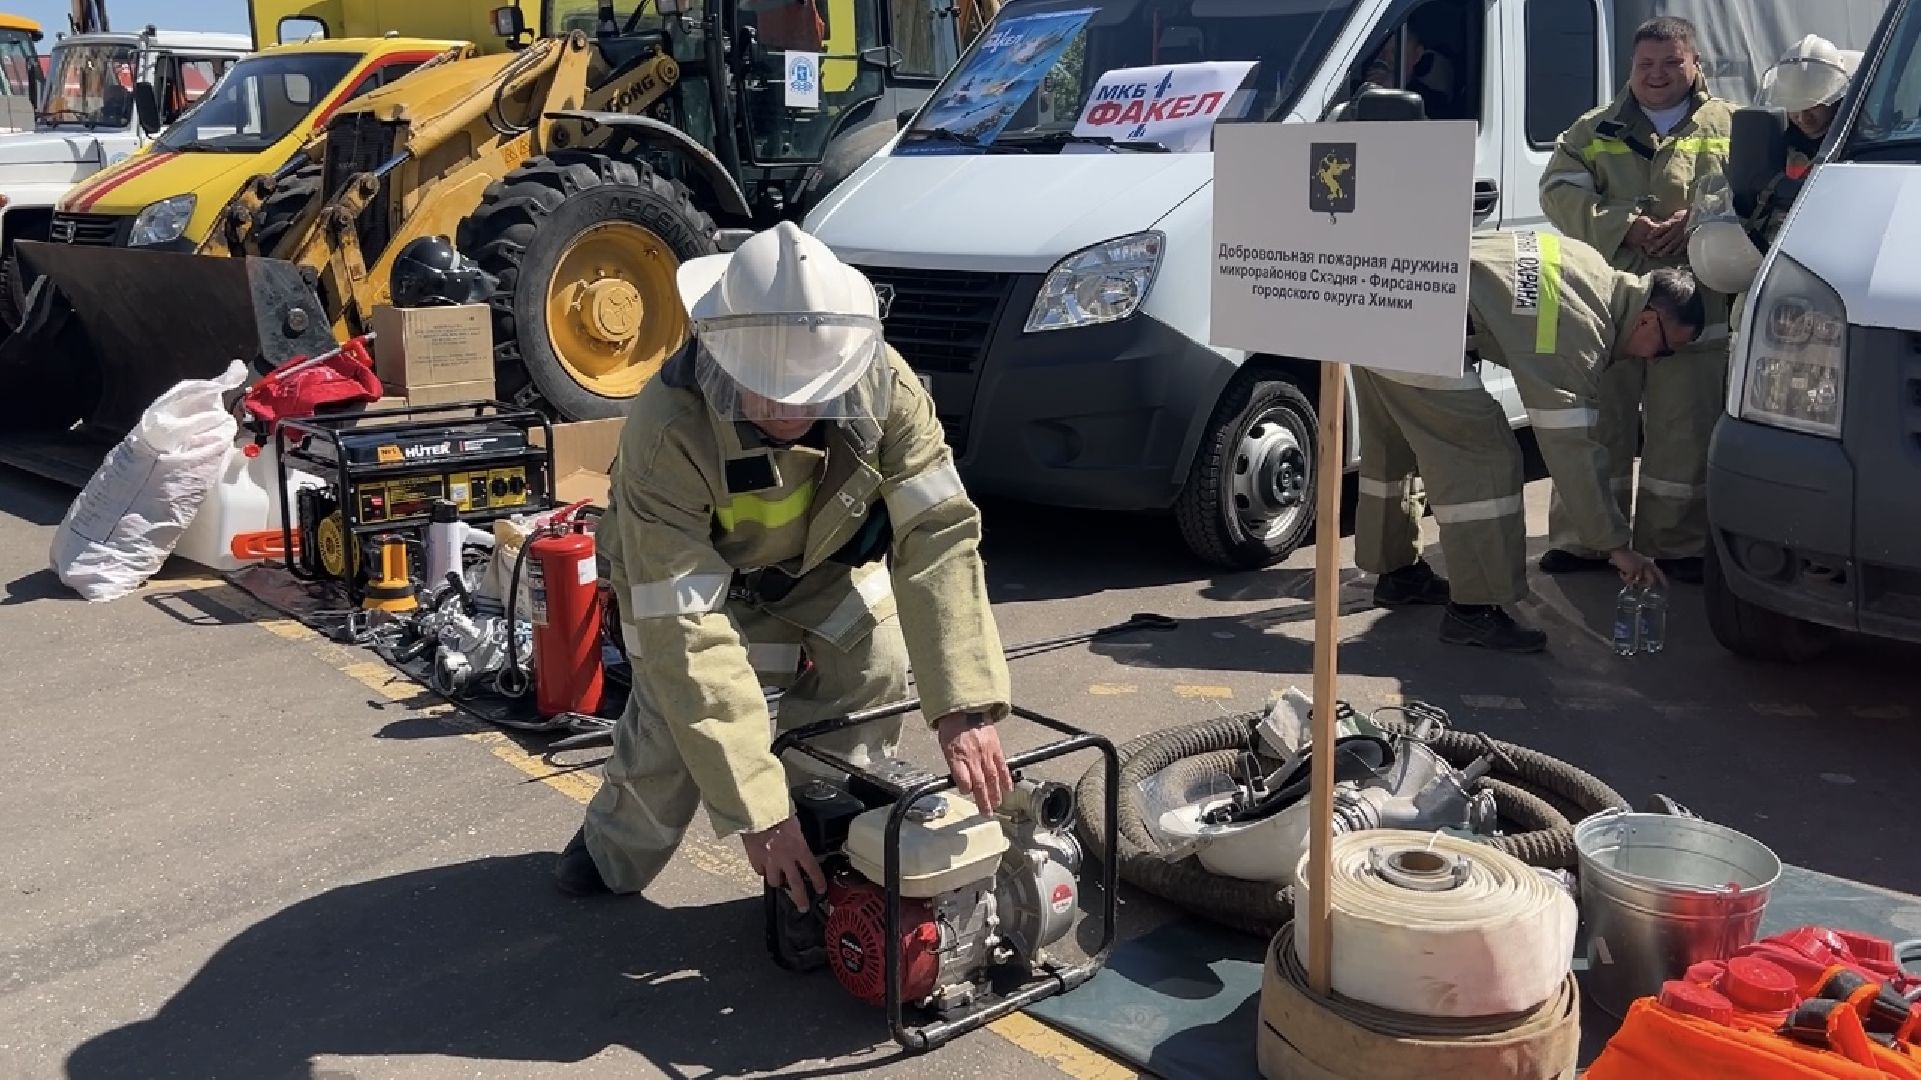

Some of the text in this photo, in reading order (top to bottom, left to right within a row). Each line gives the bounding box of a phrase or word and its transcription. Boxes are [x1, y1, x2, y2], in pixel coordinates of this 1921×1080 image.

[1097, 83, 1147, 100] МКБ
[1086, 91, 1225, 126] ФАКЕЛ
[1219, 243, 1459, 275] Добровольная пожарная дружина
[1219, 264, 1307, 282] микрорайонов
[1370, 272, 1456, 294] Фирсановка
[1517, 257, 1539, 308] ОХРАНА
[1252, 284, 1413, 309] городского округа Химки
[405, 441, 451, 458] HÜTER
